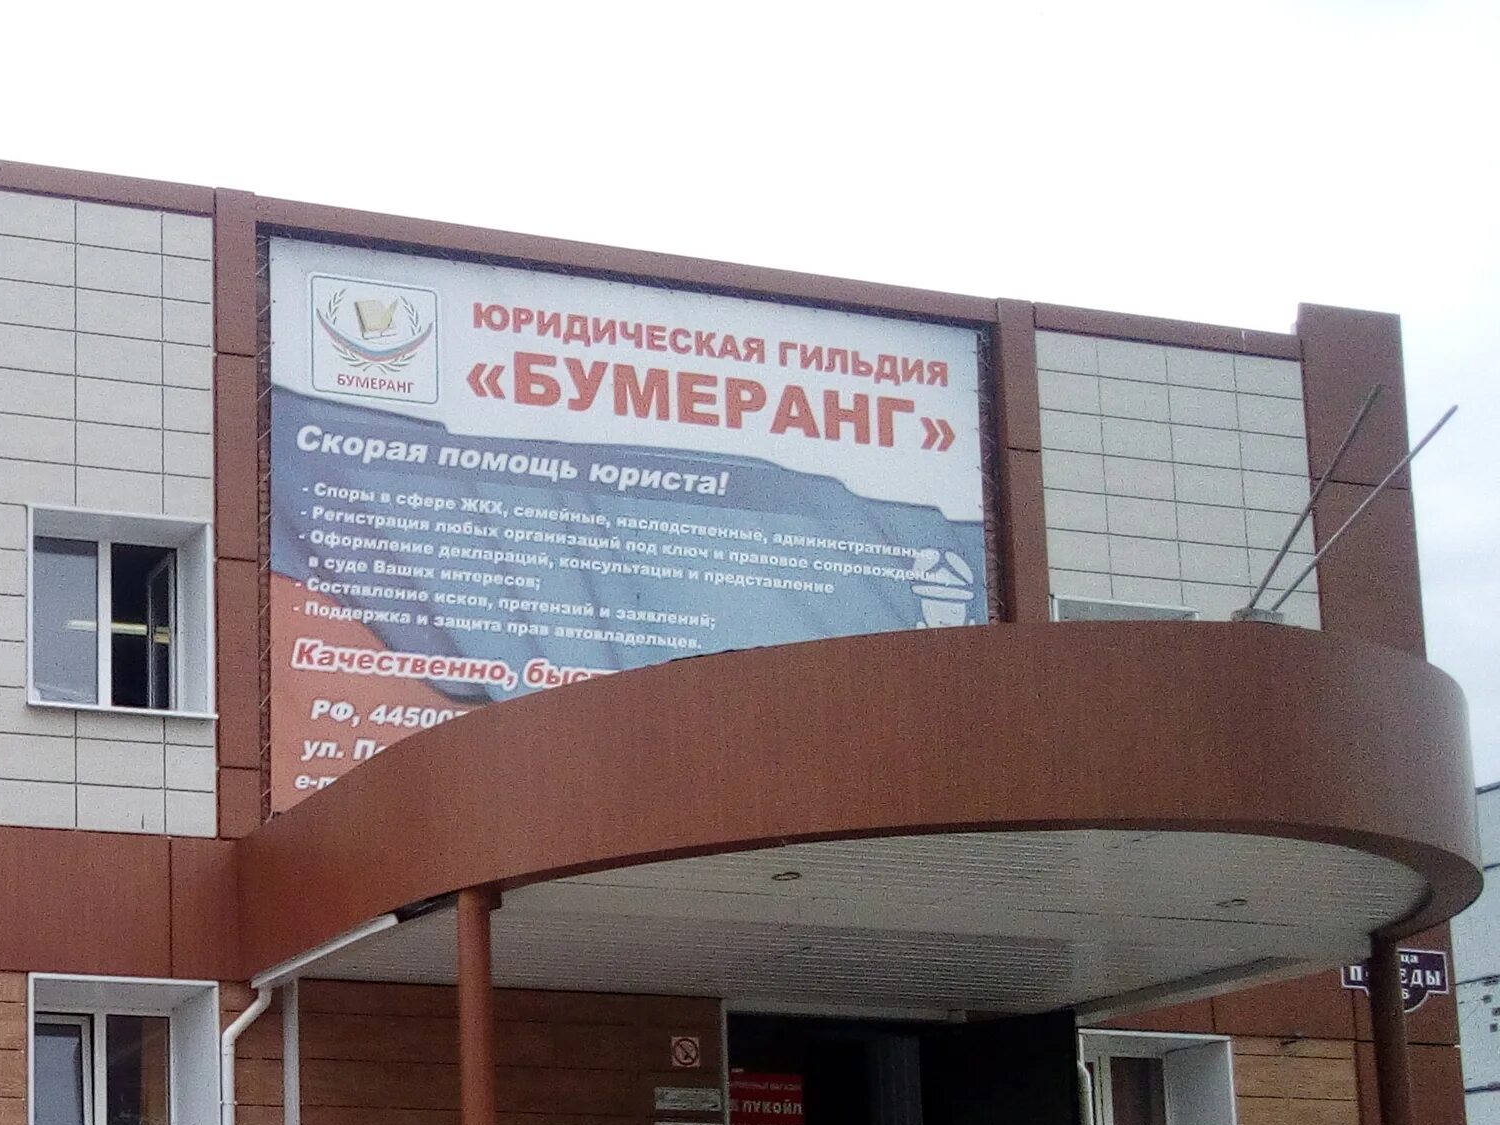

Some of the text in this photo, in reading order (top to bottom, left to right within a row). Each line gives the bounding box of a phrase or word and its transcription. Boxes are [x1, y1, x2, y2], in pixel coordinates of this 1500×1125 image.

[472, 302, 949, 387] ЮРИДИЧЕСКАЯ ГИЛЬДИЯ
[337, 374, 415, 394] БУМЕРАНГ
[466, 351, 956, 451] «БУМЕРАНГ»
[297, 425, 729, 495] Скорая помощь юриста!
[312, 506, 430, 531] Регистрация
[435, 521, 498, 537] любых
[504, 527, 620, 550] организаций
[625, 541, 657, 556] под
[662, 545, 708, 558] ключ
[714, 548, 725, 560] и
[729, 549, 809, 568] правовое
[314, 482, 375, 502] Споры
[380, 491, 391, 503] в
[396, 493, 456, 512] сфере
[460, 498, 509, 518] ЖКХ,
[514, 505, 611, 528] семейные,
[617, 515, 768, 544] наследственные,
[308, 556, 541, 591] в суде Ваших интересов;
[310, 530, 835, 594] Оформление деклараций, консультации и представление
[305, 601, 702, 649] Поддержка и защита прав автовладельцев.
[307, 578, 716, 630] Составление исков, претензий и заявлений;
[294, 640, 605, 688] Качественно, быс
[311, 700, 469, 729] РФ, 44500
[301, 740, 345, 761] ул.
